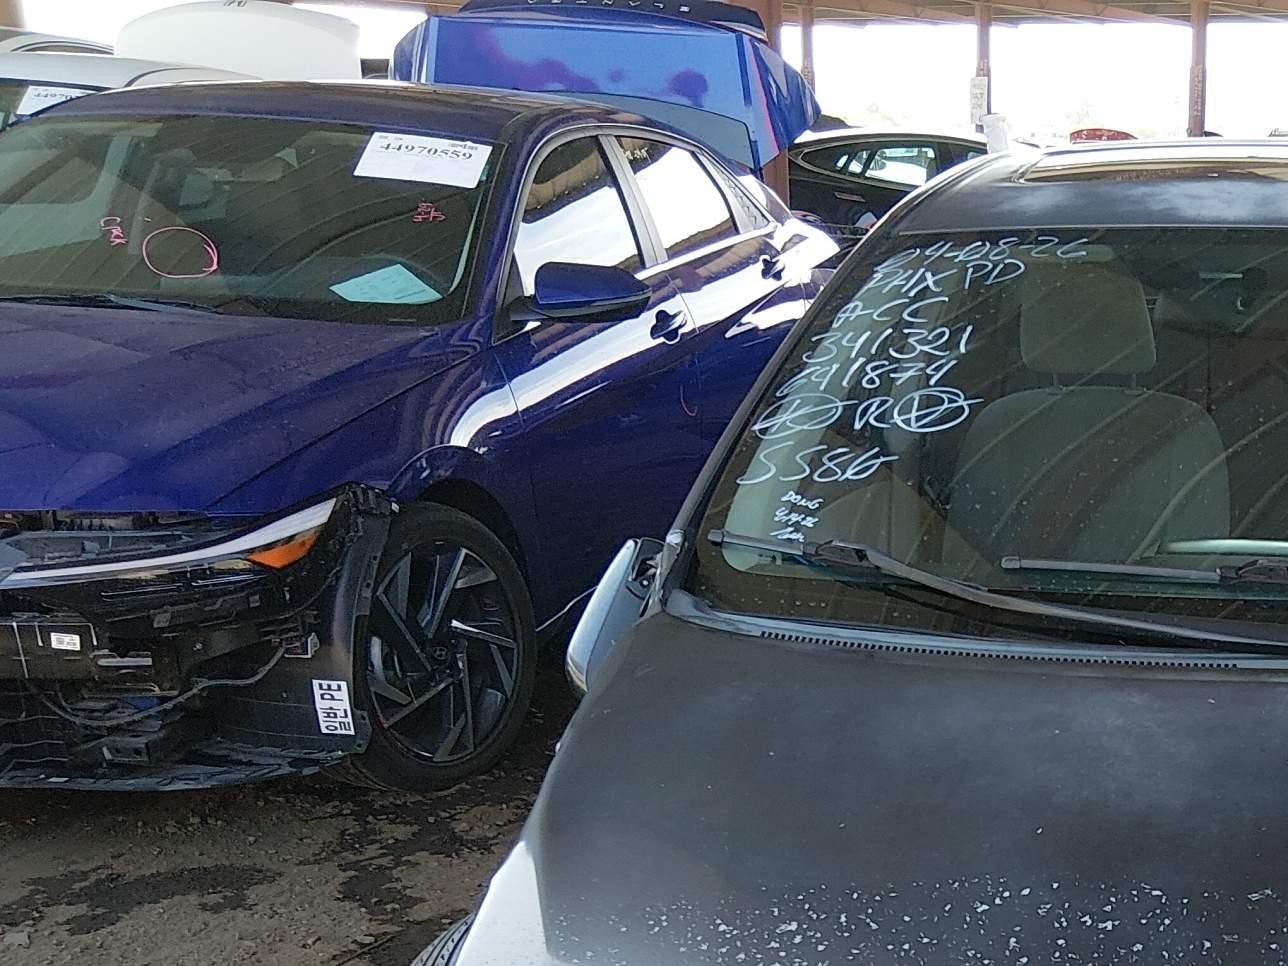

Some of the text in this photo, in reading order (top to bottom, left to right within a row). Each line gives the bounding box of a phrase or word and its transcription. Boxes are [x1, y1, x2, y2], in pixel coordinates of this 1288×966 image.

[379, 142, 474, 161] 44970559
[853, 259, 1026, 298] PHX PD
[831, 296, 950, 329] ACC
[318, 682, 344, 702] PE
